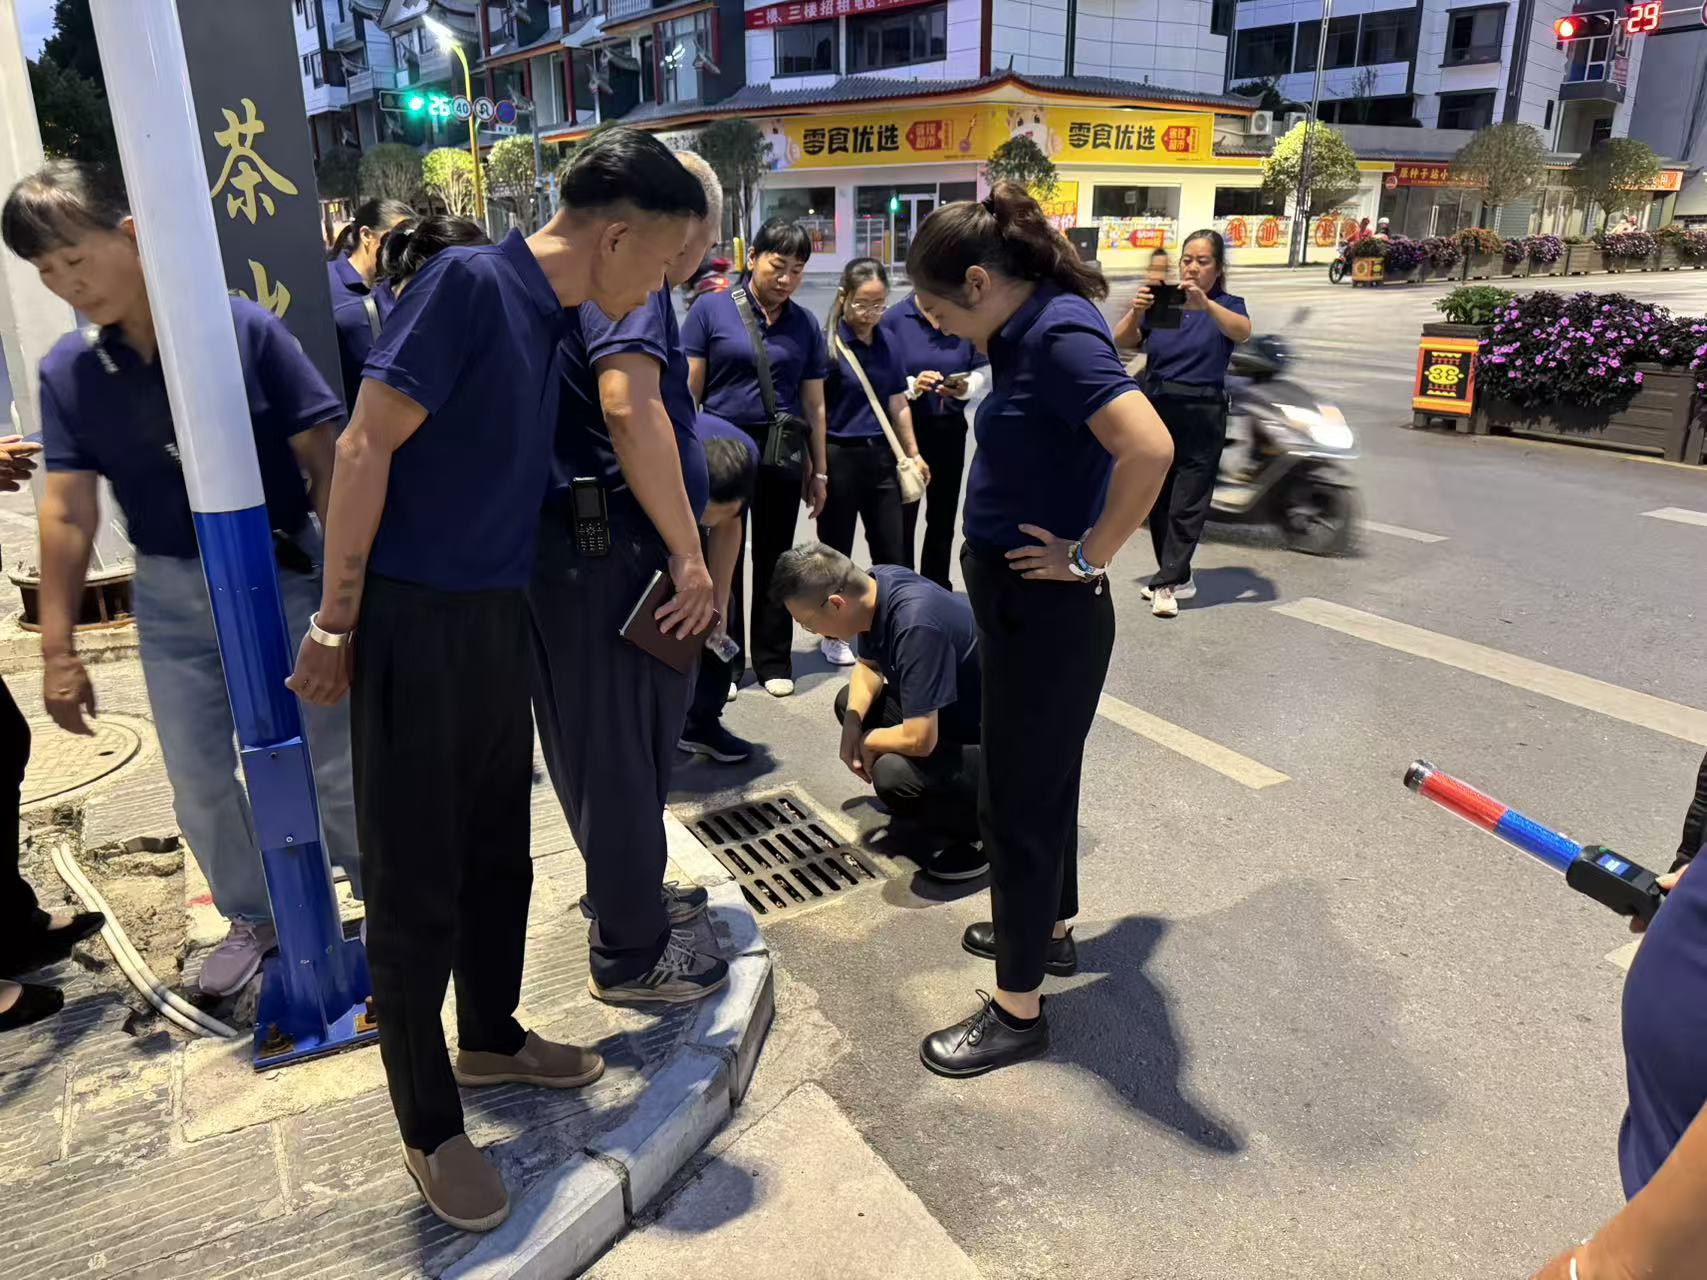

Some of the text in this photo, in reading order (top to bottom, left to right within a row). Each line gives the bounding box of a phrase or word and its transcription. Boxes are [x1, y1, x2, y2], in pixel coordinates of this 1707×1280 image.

[1627, 3, 1660, 33] 29
[428, 95, 451, 116] 26
[455, 102, 469, 115] 40
[803, 124, 900, 155] 零食优选
[1069, 122, 1156, 151] 零食优选
